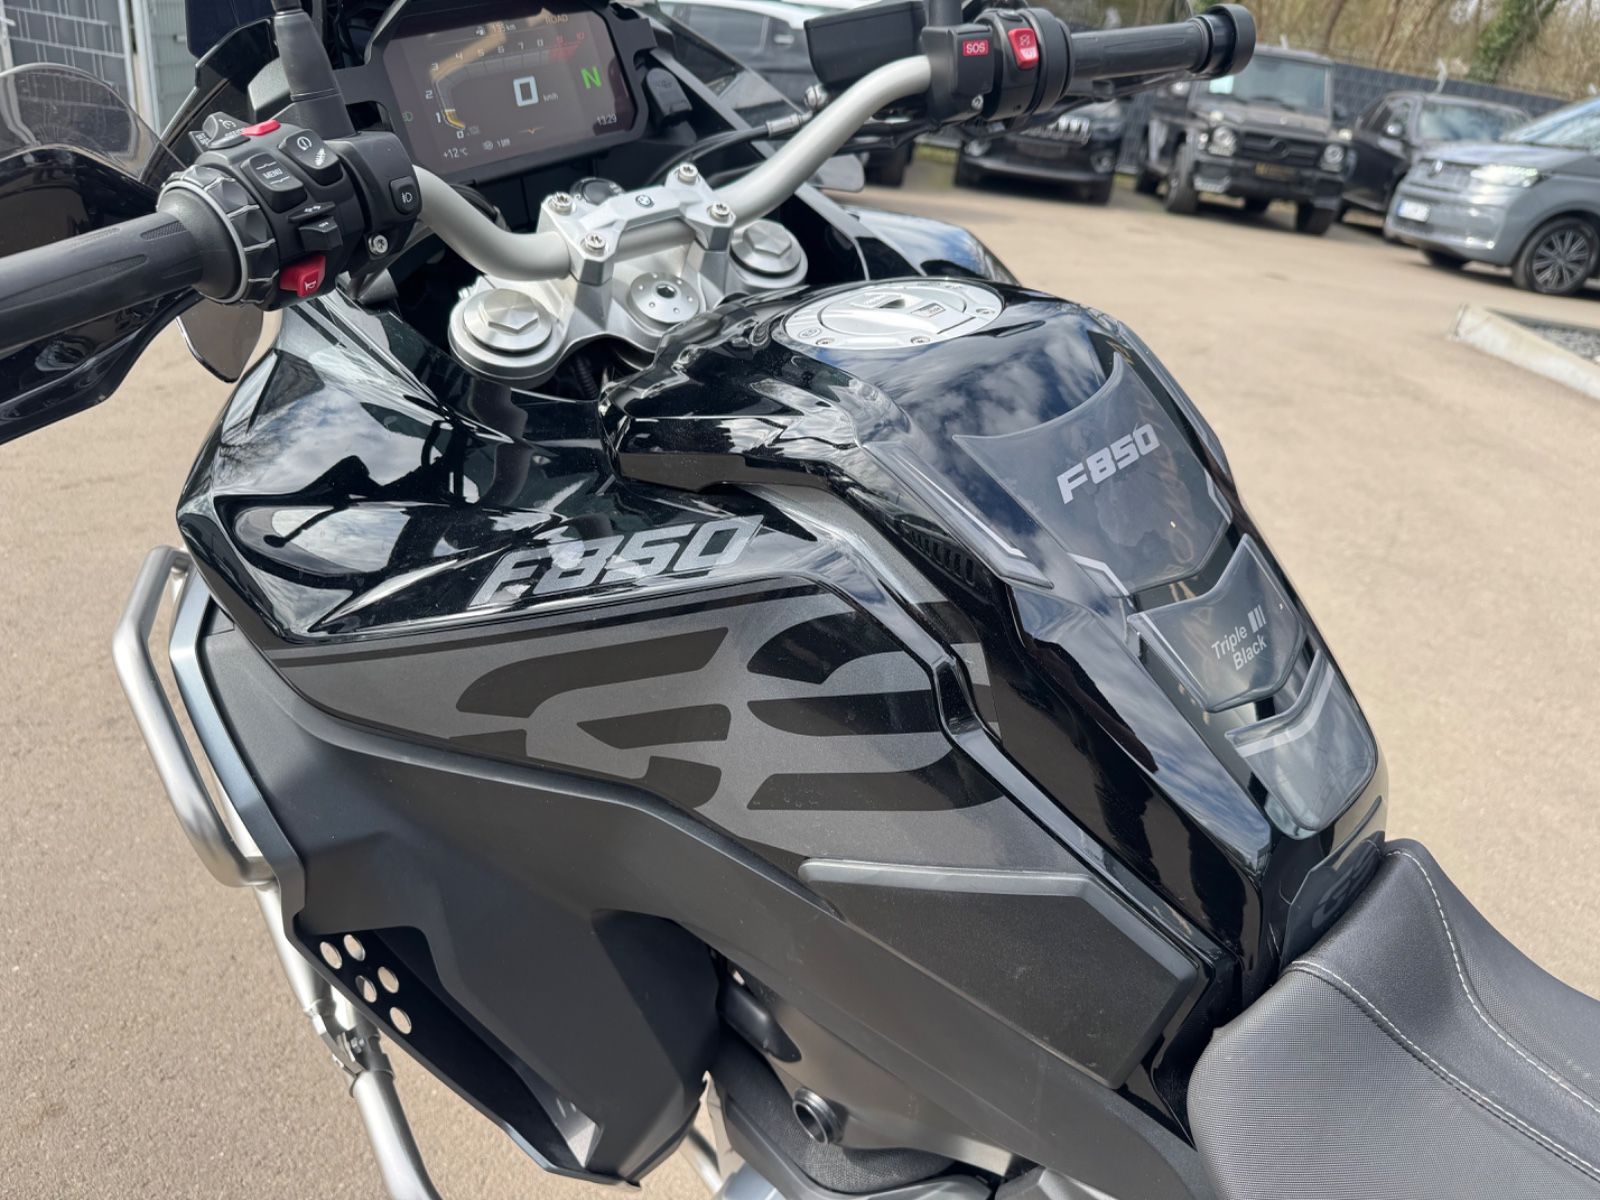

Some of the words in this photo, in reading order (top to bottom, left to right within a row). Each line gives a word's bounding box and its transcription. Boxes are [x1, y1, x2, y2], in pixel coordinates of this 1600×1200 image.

[966, 42, 985, 54] SOS
[455, 51, 463, 60] 4
[431, 62, 439, 71] 3
[580, 66, 602, 89] N
[425, 90, 434, 99] 2
[513, 75, 539, 107] 0
[435, 112, 442, 123] 1
[456, 130, 465, 139] 0
[262, 167, 284, 179] MENU
[1057, 422, 1161, 505] F850
[467, 514, 764, 608] F850
[1211, 625, 1248, 661] Triple
[1232, 636, 1268, 671] Black
